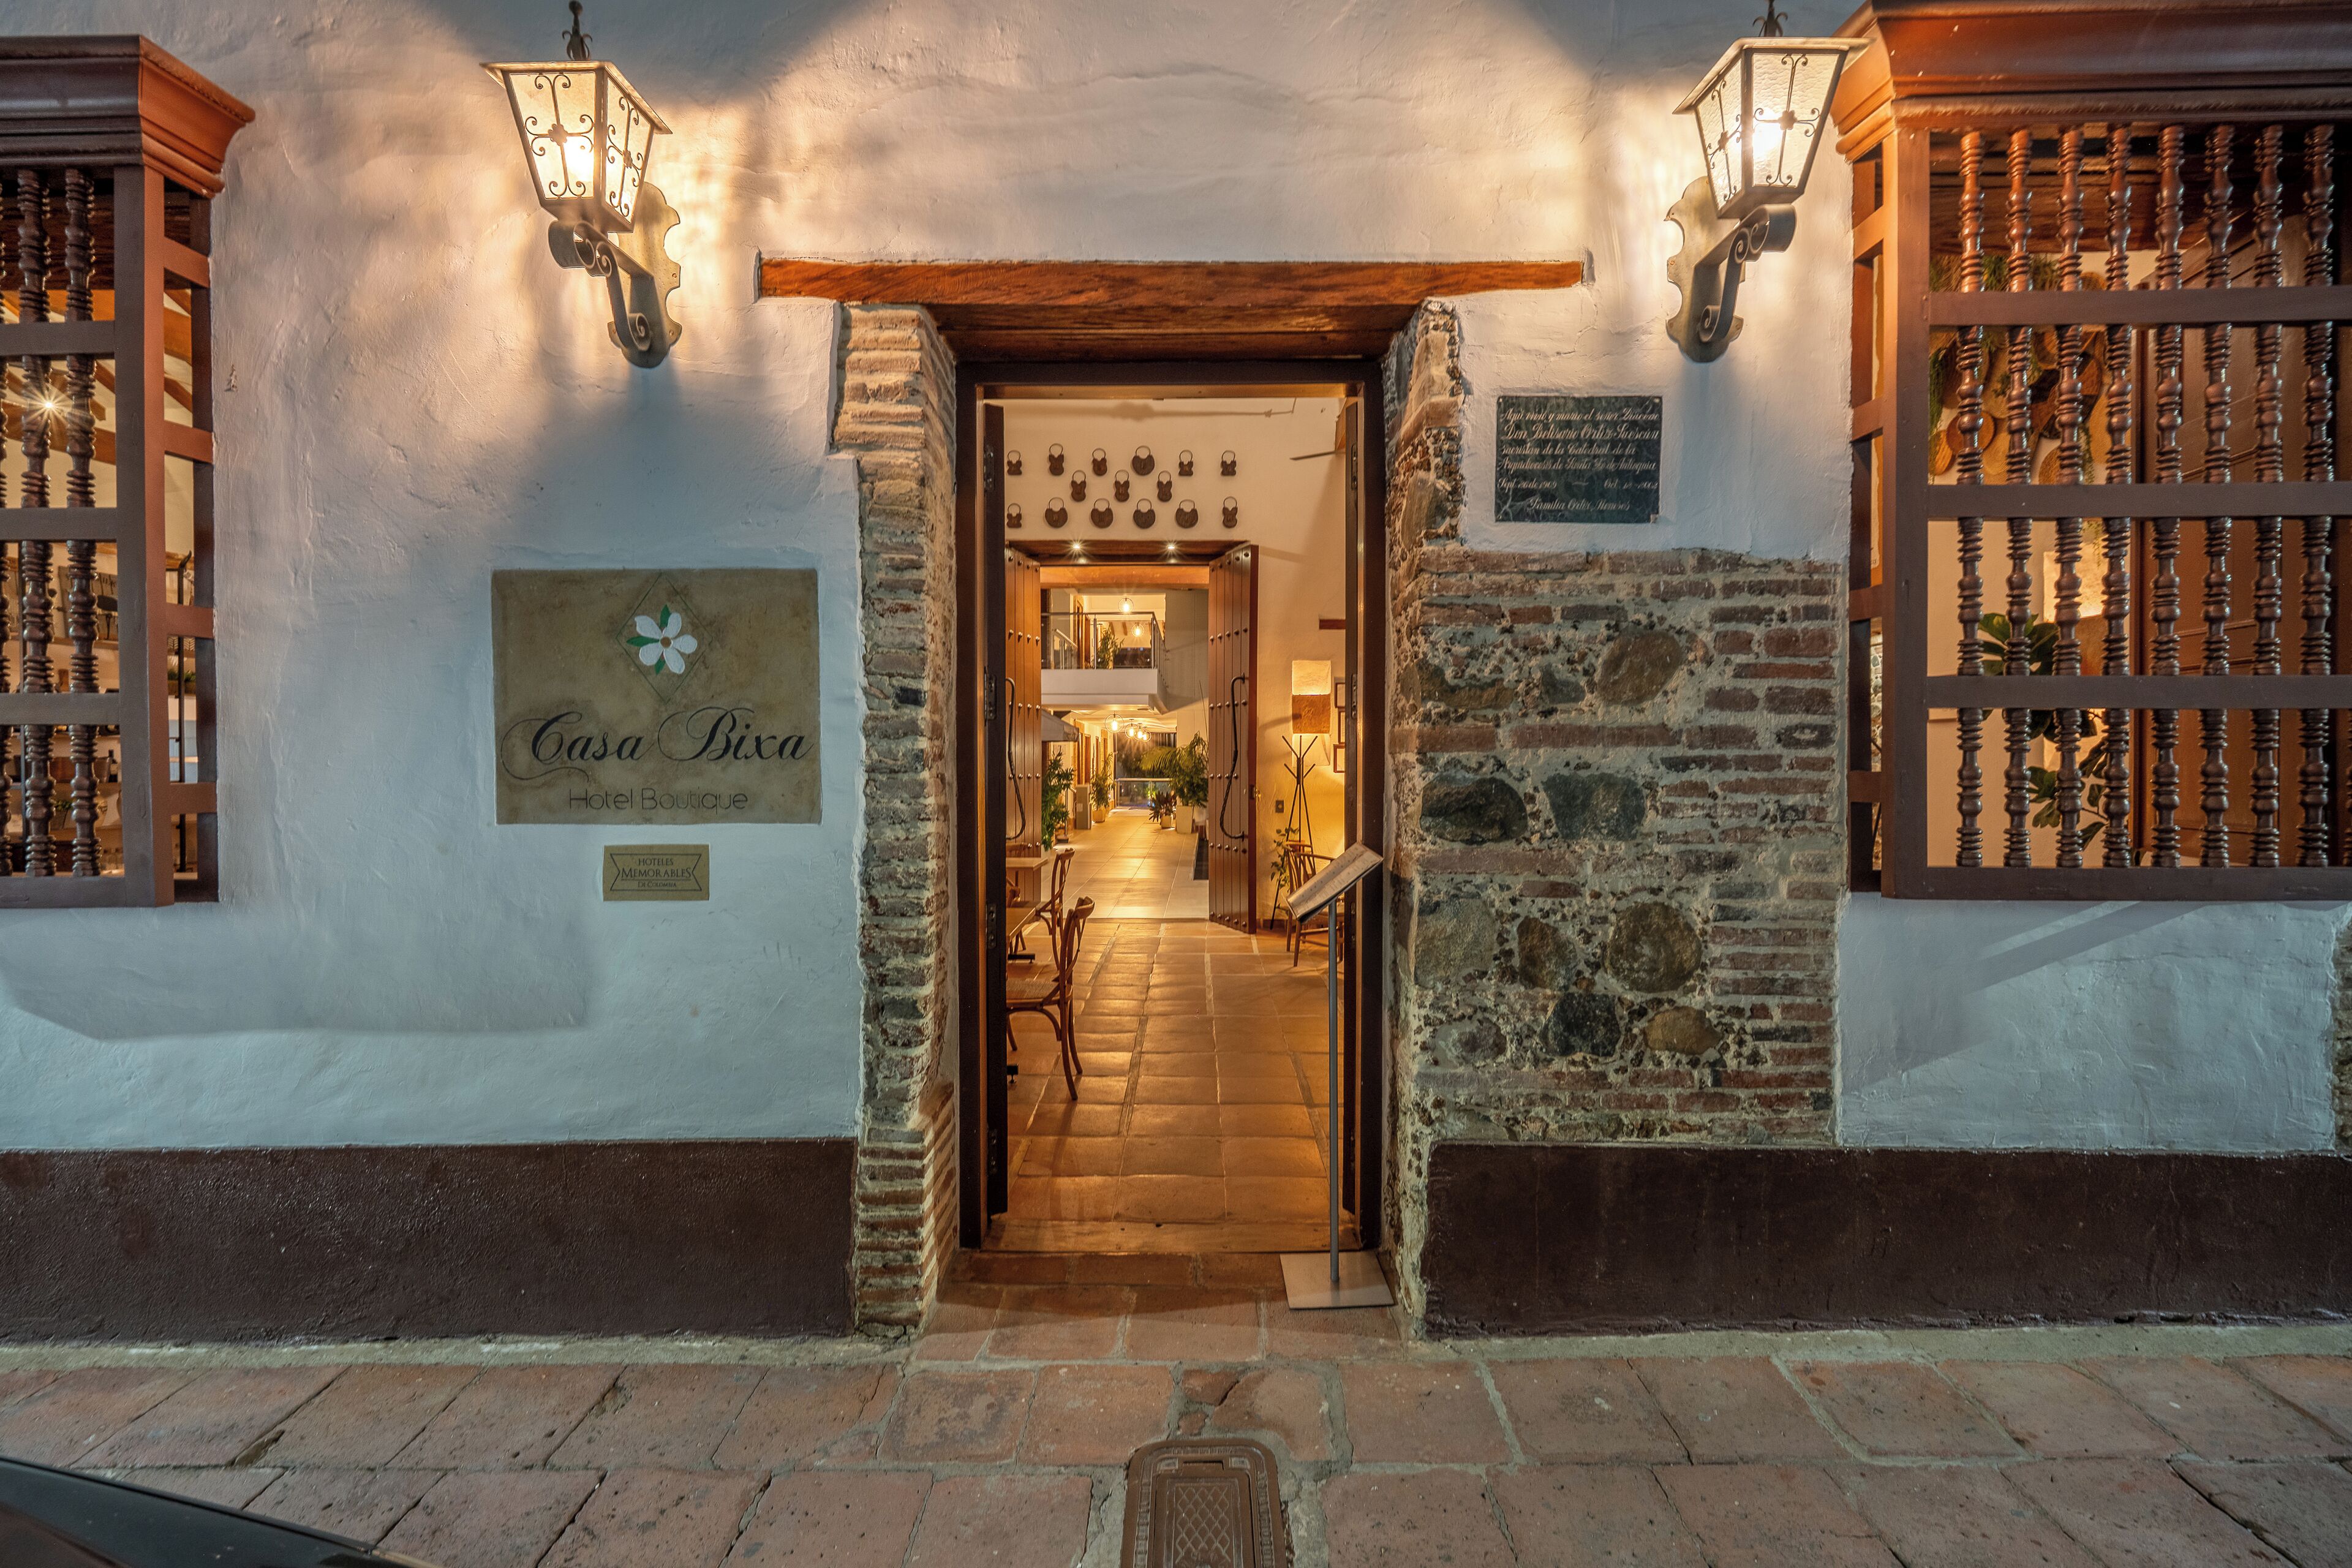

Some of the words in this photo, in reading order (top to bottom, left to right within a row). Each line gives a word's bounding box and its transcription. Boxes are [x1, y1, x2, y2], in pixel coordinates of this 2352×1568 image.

[1544, 413, 1555, 423] y
[1583, 408, 1595, 420] el
[1500, 423, 1528, 440] Don
[1529, 423, 1580, 440] Belisario
[1580, 424, 1614, 440] Ortiz
[1542, 442, 1554, 454] de
[1554, 442, 1565, 454] la
[1567, 442, 1610, 454] Catedral
[1612, 442, 1624, 454] de
[1624, 442, 1636, 454] la
[1553, 457, 1563, 469] de
[1564, 457, 1591, 470] Santa
[1606, 458, 1615, 470] de
[1613, 457, 1656, 475] Antioquia
[1529, 478, 1538, 489] de
[1529, 497, 1566, 510] Familia
[1567, 498, 1592, 510] Ortiz
[1593, 498, 1630, 511] Meneses
[500, 710, 654, 783] Casa
[657, 706, 814, 761] Bixa
[569, 788, 632, 809] Hotel
[641, 786, 748, 815] Boutique
[621, 867, 692, 878] MEMORABLES
